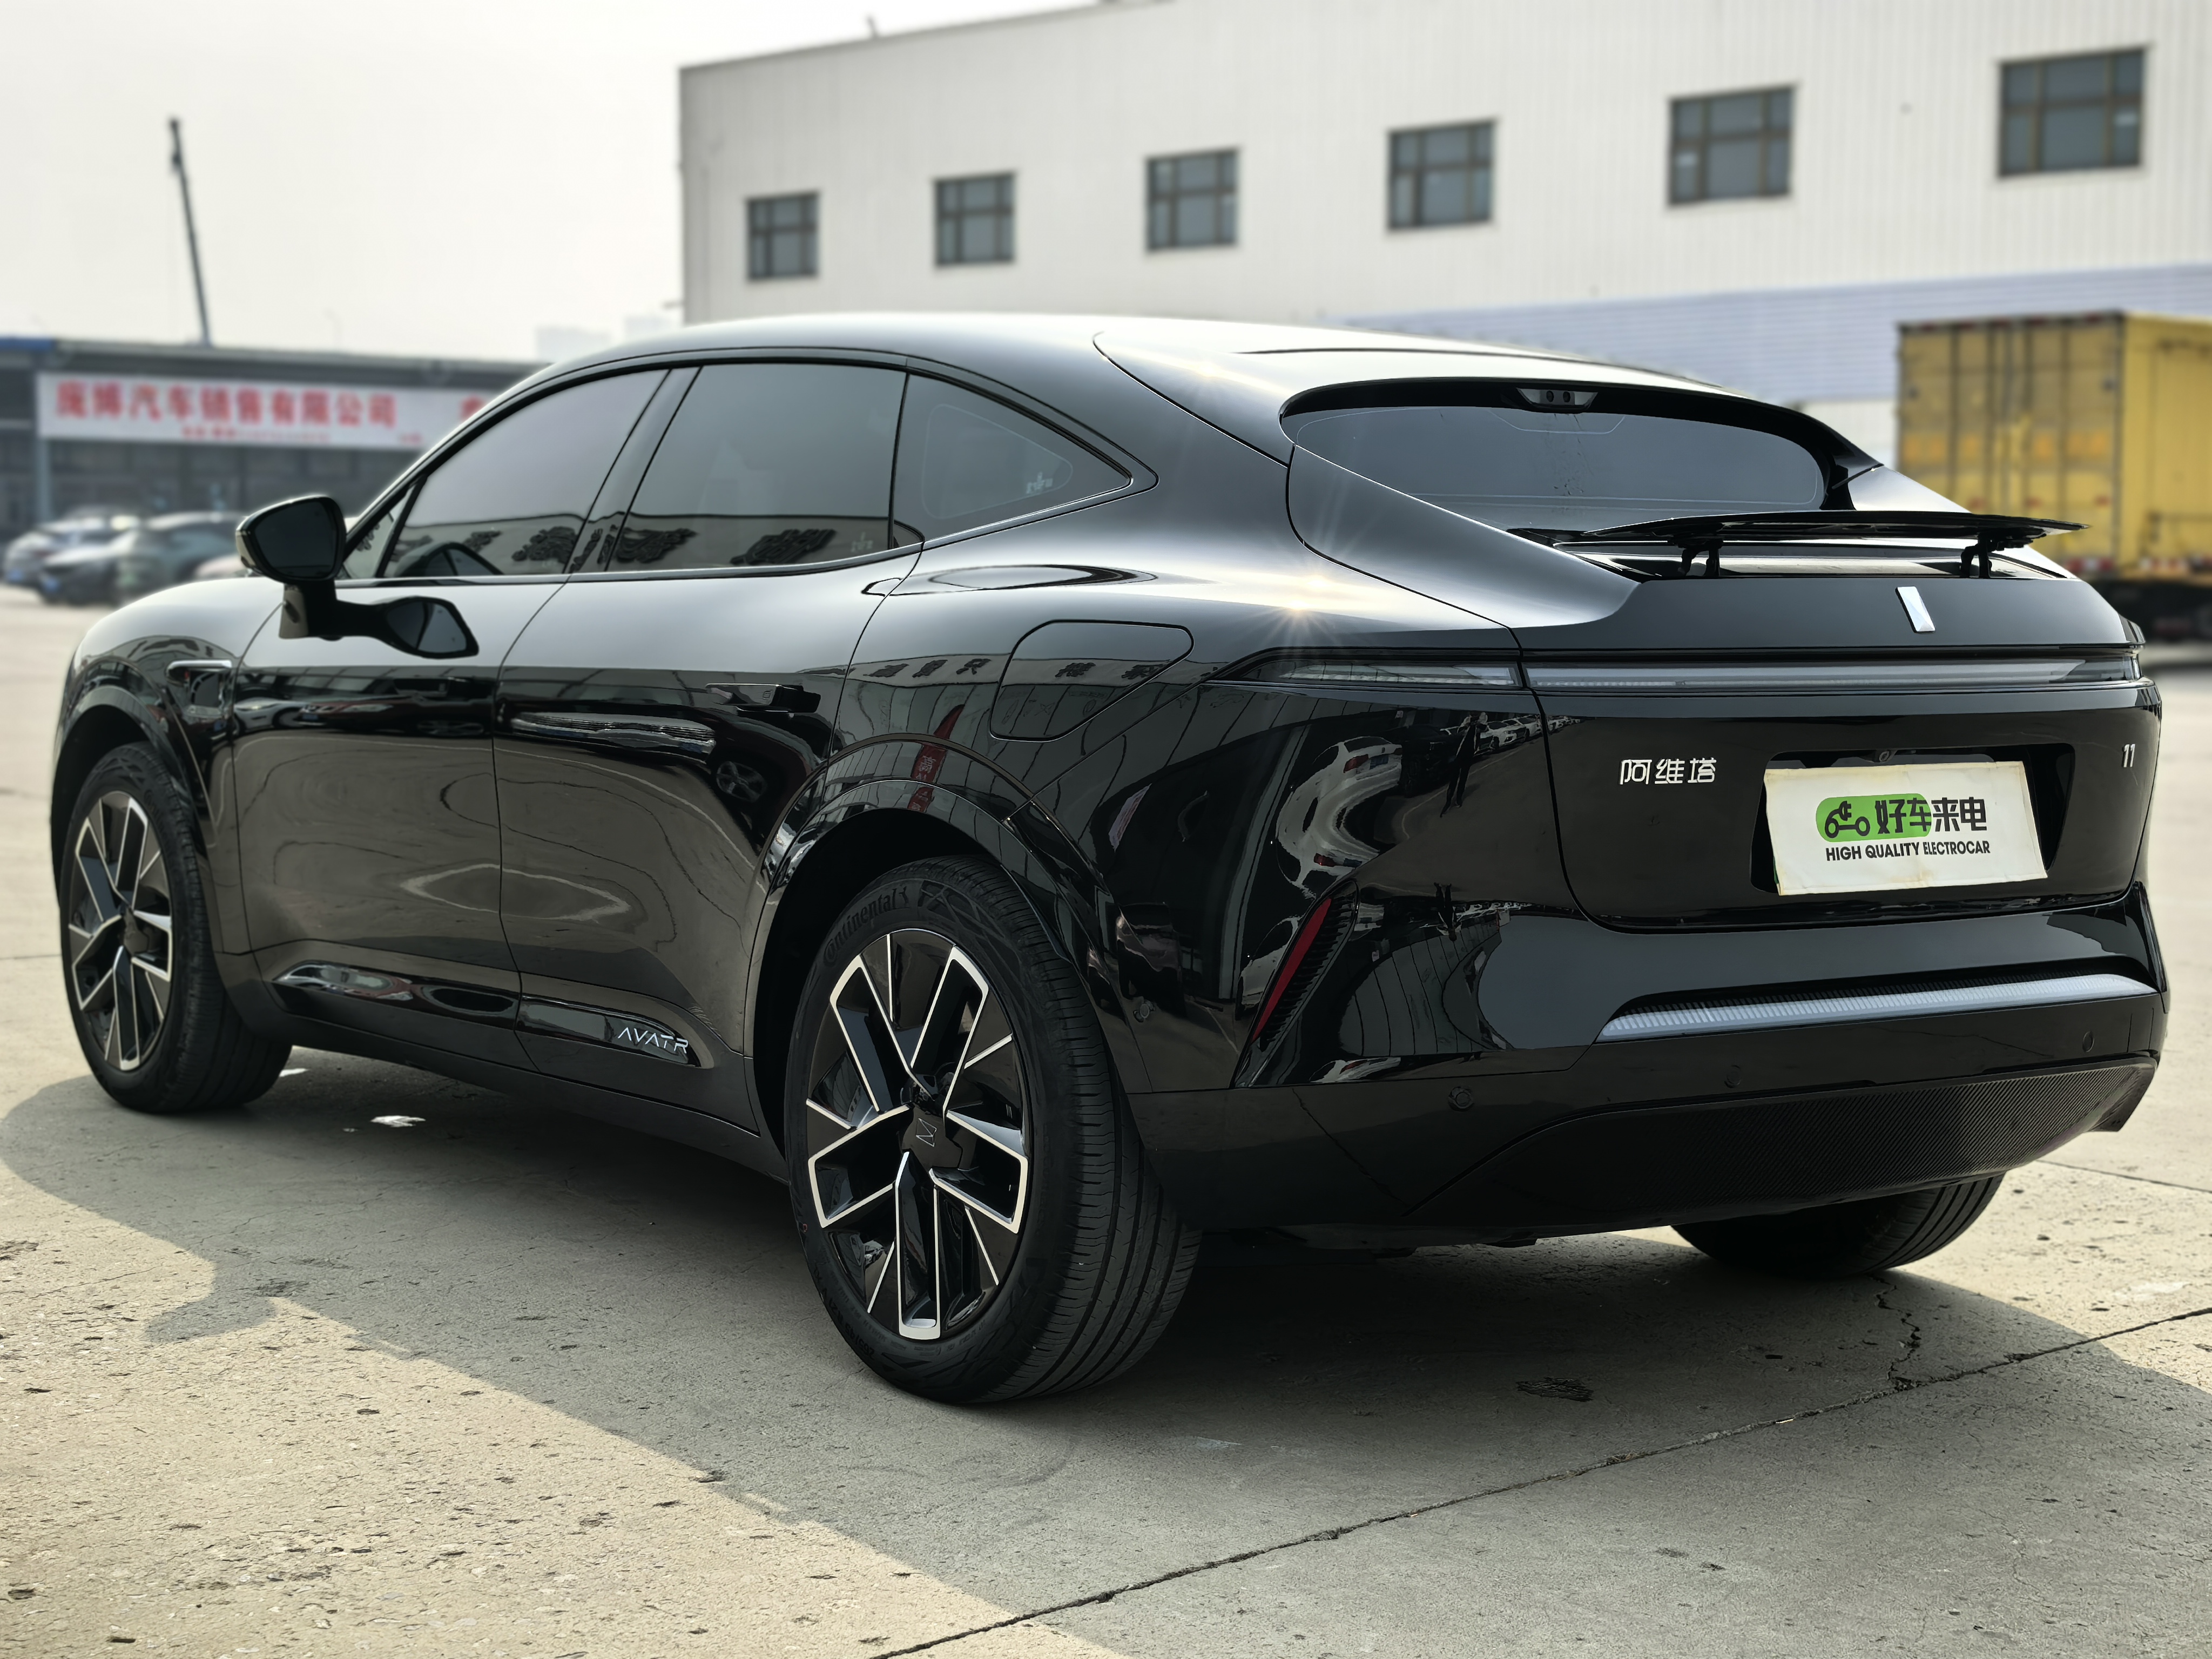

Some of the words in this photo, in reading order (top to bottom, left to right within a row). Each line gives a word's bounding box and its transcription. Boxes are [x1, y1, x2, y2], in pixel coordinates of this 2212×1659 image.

[2123, 744, 2135, 767] 11
[1620, 757, 1716, 785] 阿维塔
[1875, 797, 1987, 834] 好车来电
[1826, 846, 1862, 861] HIGH
[1865, 842, 1919, 859] QUALITY
[1924, 840, 1991, 855] ELECTROCAR
[823, 888, 898, 967] Continental
[618, 1027, 689, 1053] AVATR
